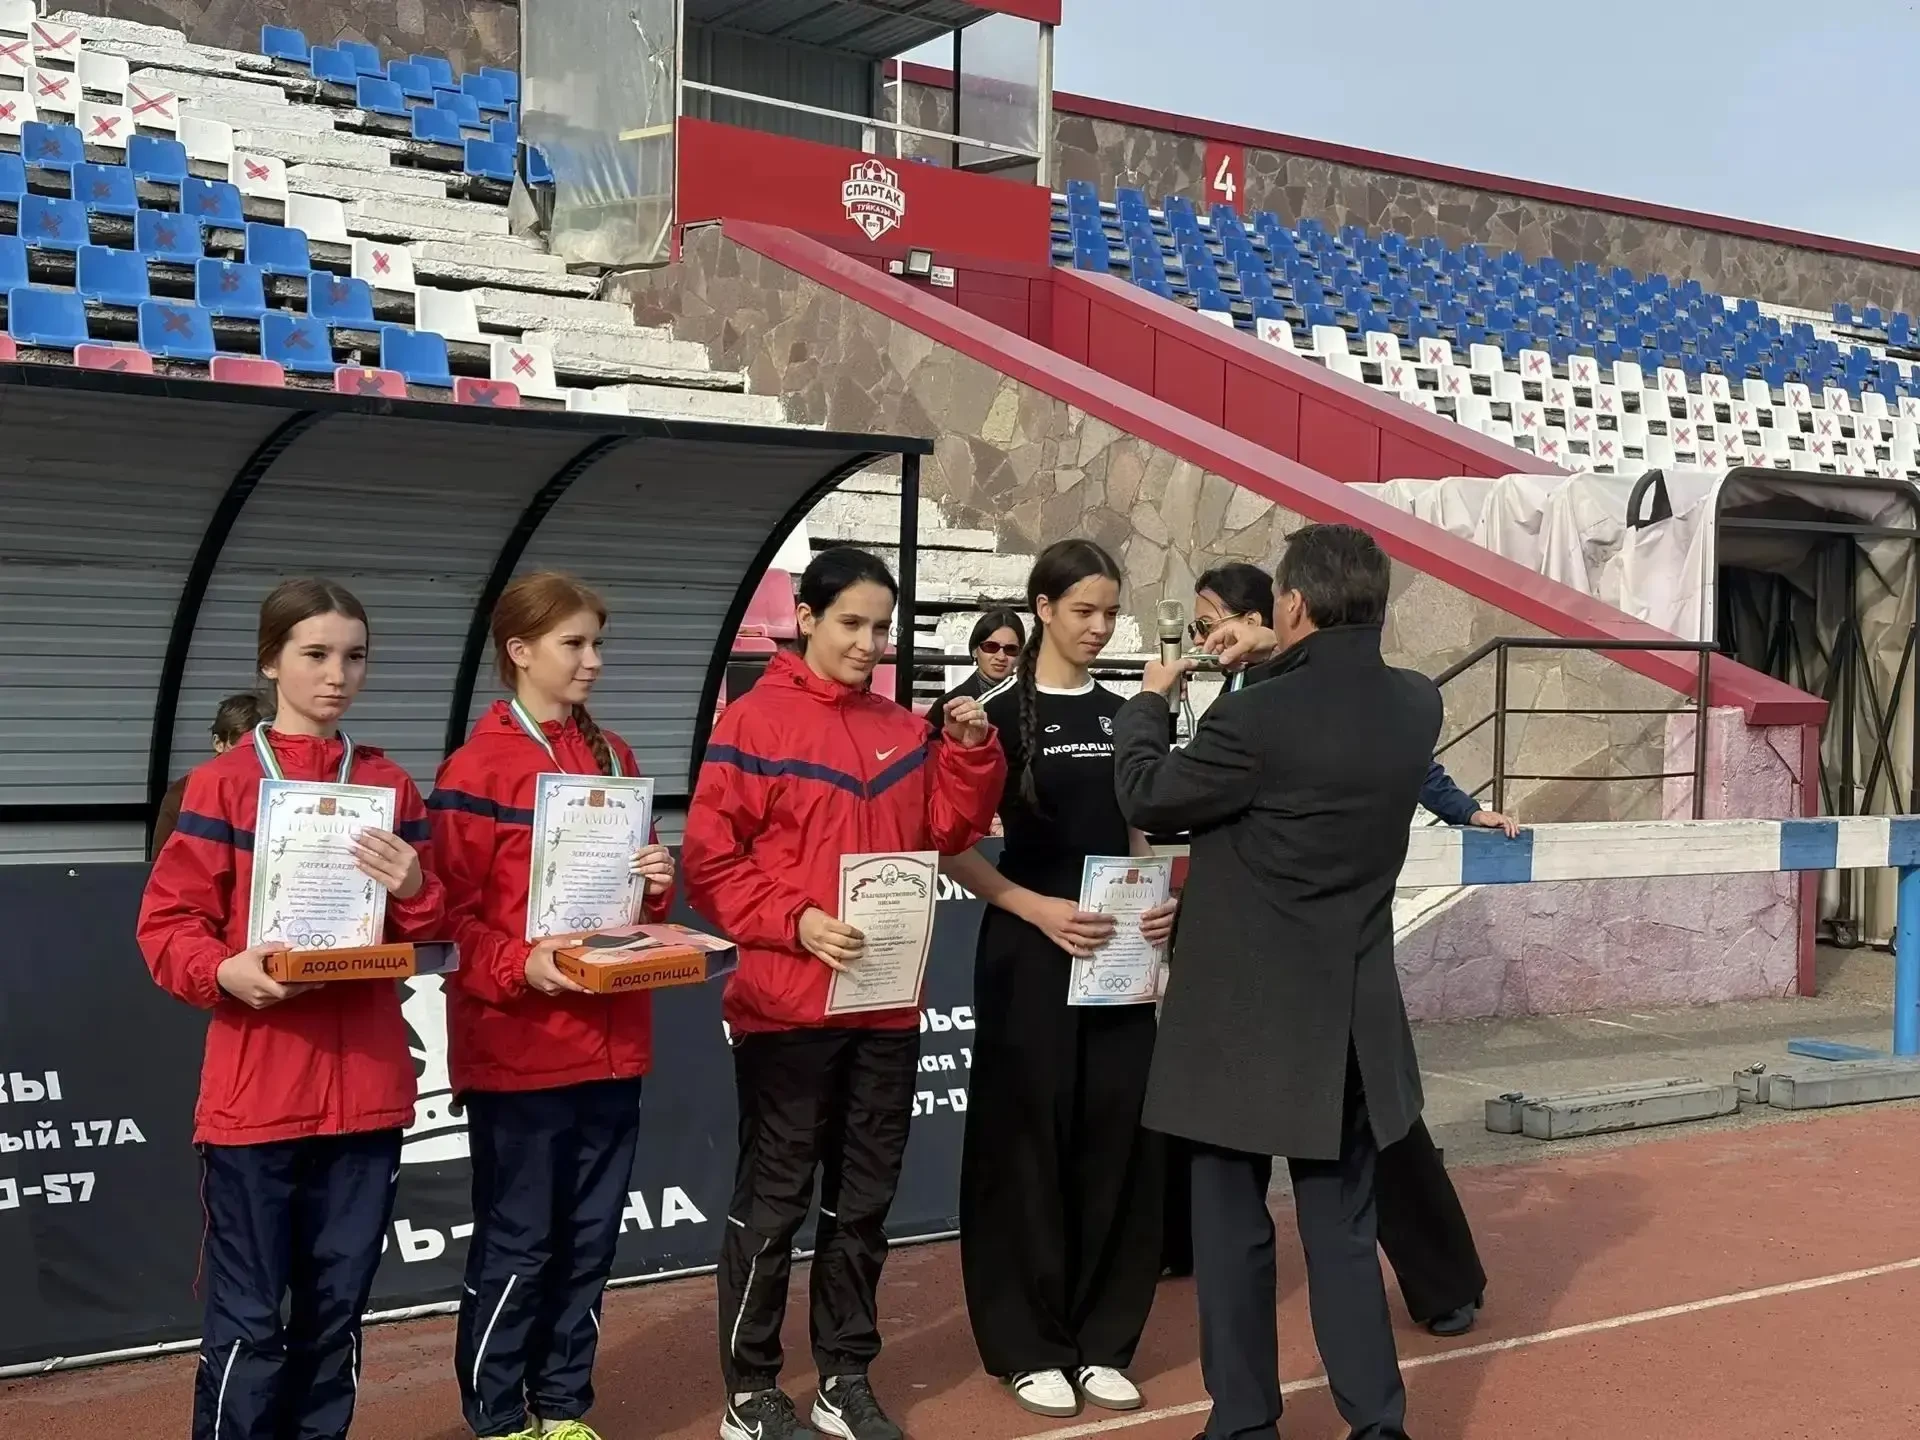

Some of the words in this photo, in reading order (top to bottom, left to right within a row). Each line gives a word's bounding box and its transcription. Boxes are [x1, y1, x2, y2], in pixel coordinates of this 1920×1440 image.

[1214, 154, 1236, 201] 4
[845, 183, 901, 206] СПАРТАК
[288, 819, 353, 835] ГРАМОТ
[562, 811, 630, 826] ГРАМОТА
[302, 960, 349, 974] ДОДО
[351, 956, 408, 970] ПИЦЦА
[611, 973, 650, 988] ДОДО
[652, 966, 700, 983] ПИЦЦА
[917, 1054, 956, 1072] ая
[71, 1118, 147, 1147] 17А
